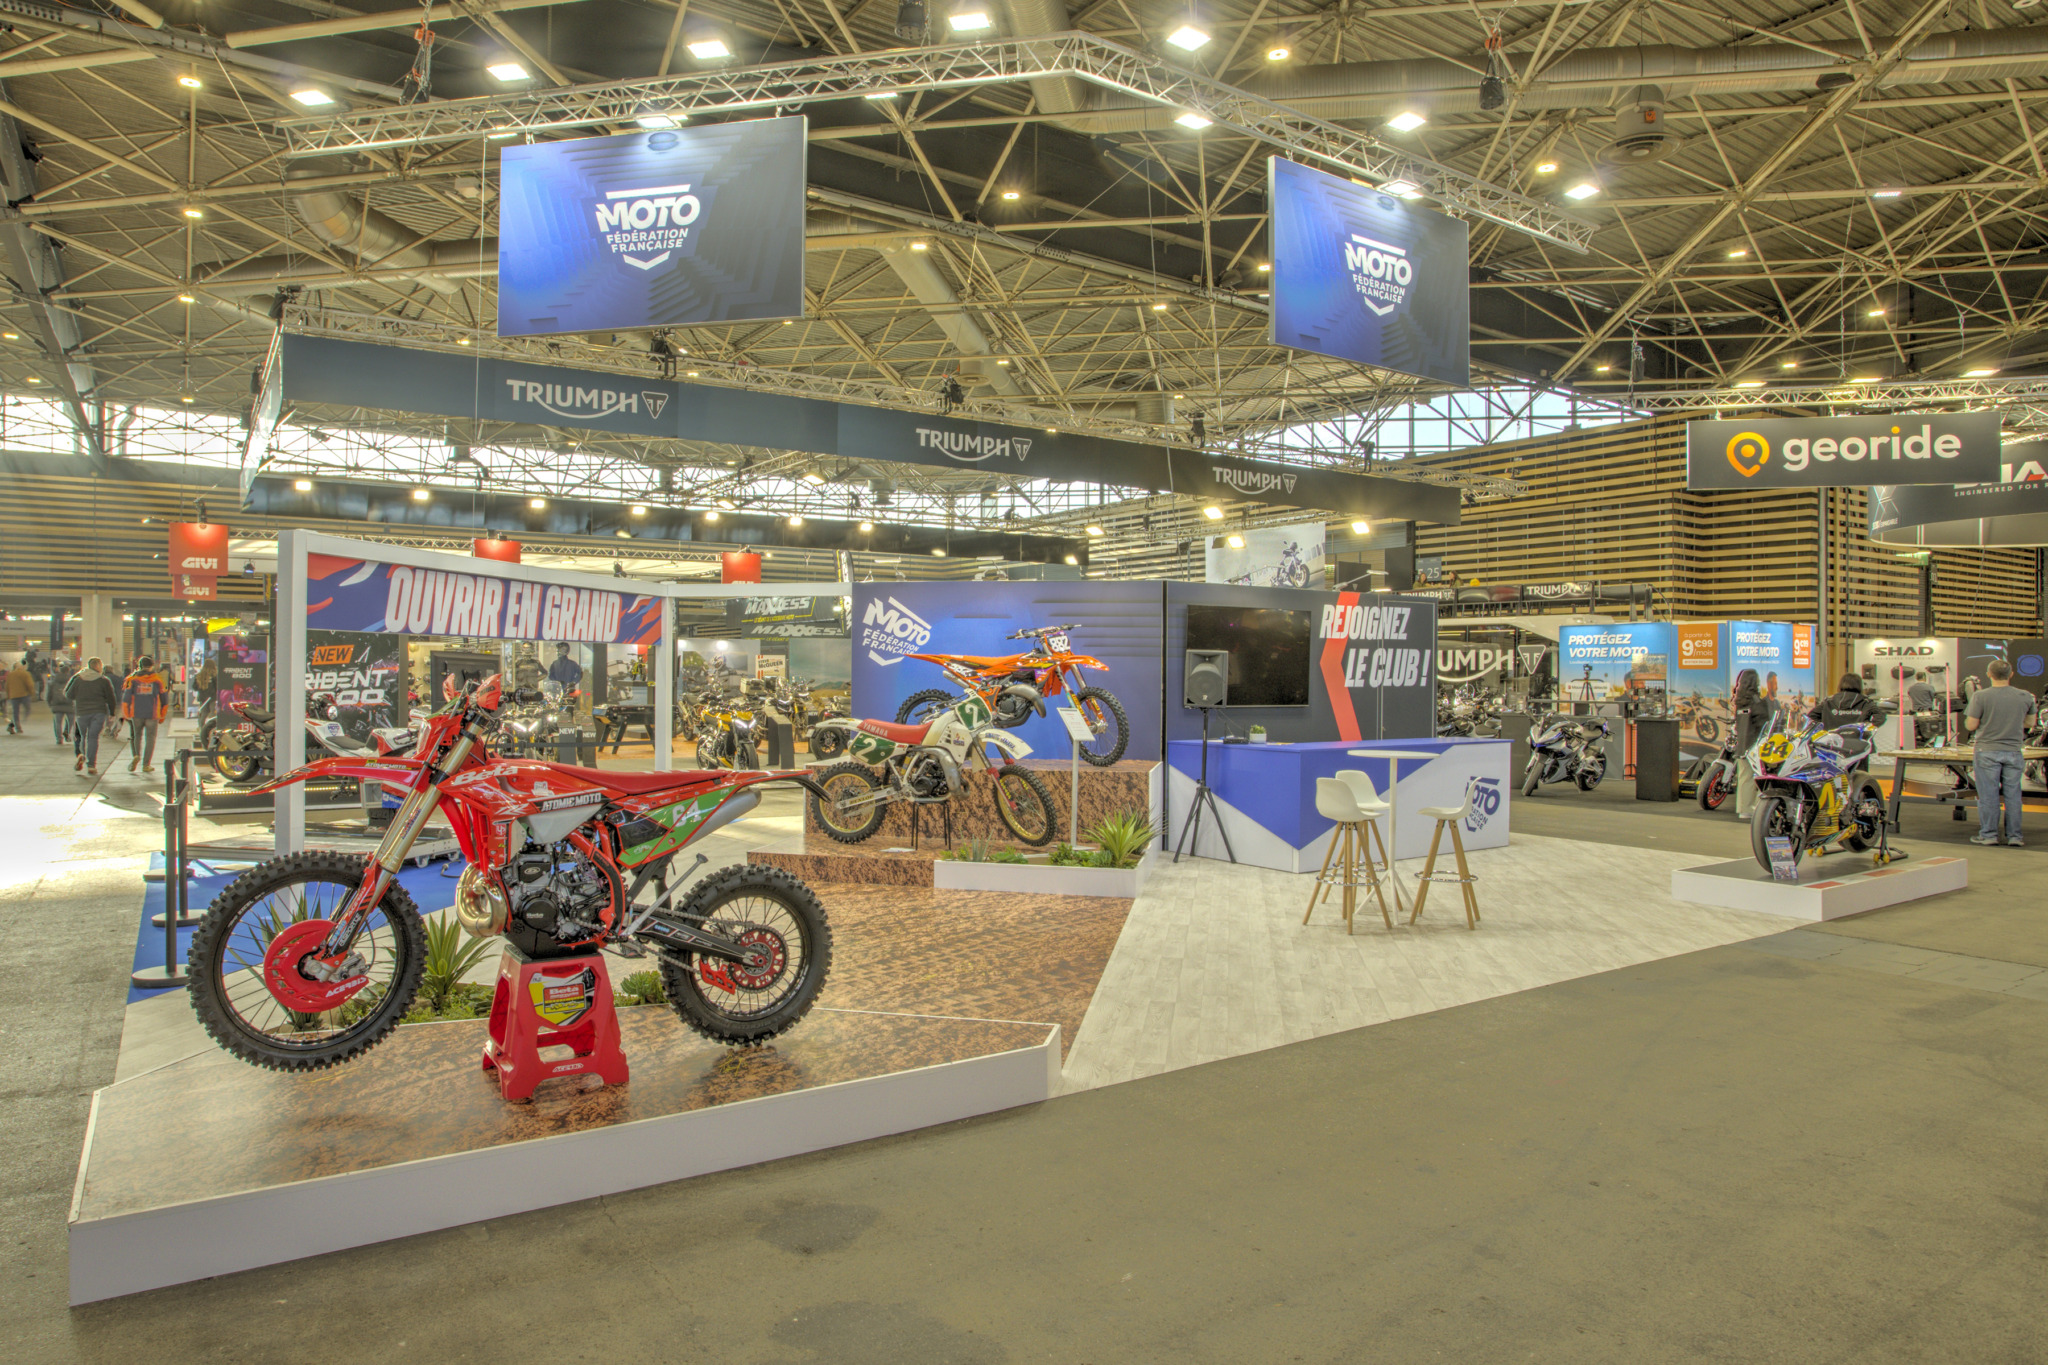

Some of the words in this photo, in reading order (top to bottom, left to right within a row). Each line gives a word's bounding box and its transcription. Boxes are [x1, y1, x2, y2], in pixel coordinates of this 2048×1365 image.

[595, 195, 700, 232] MOTO
[606, 228, 689, 244] FÉDÉRATION
[611, 239, 684, 253] FRANÇAISE
[1345, 242, 1412, 286] MOTO
[1352, 273, 1406, 296] FÉDÉRATION
[1356, 283, 1403, 303] FRANÇAISE
[506, 379, 638, 418] TRIUMPH
[916, 428, 1010, 461] TRIUMPH
[1782, 424, 1962, 472] georide
[1212, 466, 1281, 495] TRIUMPH
[1954, 485, 2013, 497] ENGINEERED
[2018, 483, 2039, 491] FOR
[181, 557, 218, 570] GIVI
[182, 586, 210, 596] GIVI
[1526, 584, 1577, 599] TRIUMPH
[384, 566, 505, 637] OUVRIR
[503, 580, 543, 640] EN
[541, 584, 623, 643] GRAND
[862, 597, 931, 646] MOTO
[1319, 604, 1411, 640] REJOIGNEZ
[862, 627, 920, 652] FÉDÉRATION
[1051, 635, 1070, 652] 882
[1568, 631, 1632, 646] PROTÉGEZ
[1736, 630, 1772, 643] PROTÉGEZ
[318, 647, 351, 663] NEW
[1569, 647, 1609, 658] VOTRE
[1609, 646, 1648, 658] MOTO
[1693, 648, 1713, 657] /mois
[1736, 646, 1759, 657] VOTRE
[1759, 646, 1779, 658] MOTO
[1874, 646, 1934, 656] SHAD
[1344, 648, 1369, 688] LE
[1369, 647, 1421, 688] CLUB
[1437, 649, 1514, 677] UMPH
[305, 669, 389, 690] RIDENT
[965, 702, 985, 729] 2
[560, 727, 575, 735] NEW
[863, 722, 888, 737] YAMAHA
[855, 737, 877, 763] 2
[1760, 740, 1790, 758] 94
[453, 765, 518, 786] Beta
[541, 796, 577, 812] ATOMIC
[576, 792, 601, 806] MOTO
[672, 799, 702, 828] 64
[325, 976, 367, 998] ACERBIS
[549, 986, 579, 995] Beta
